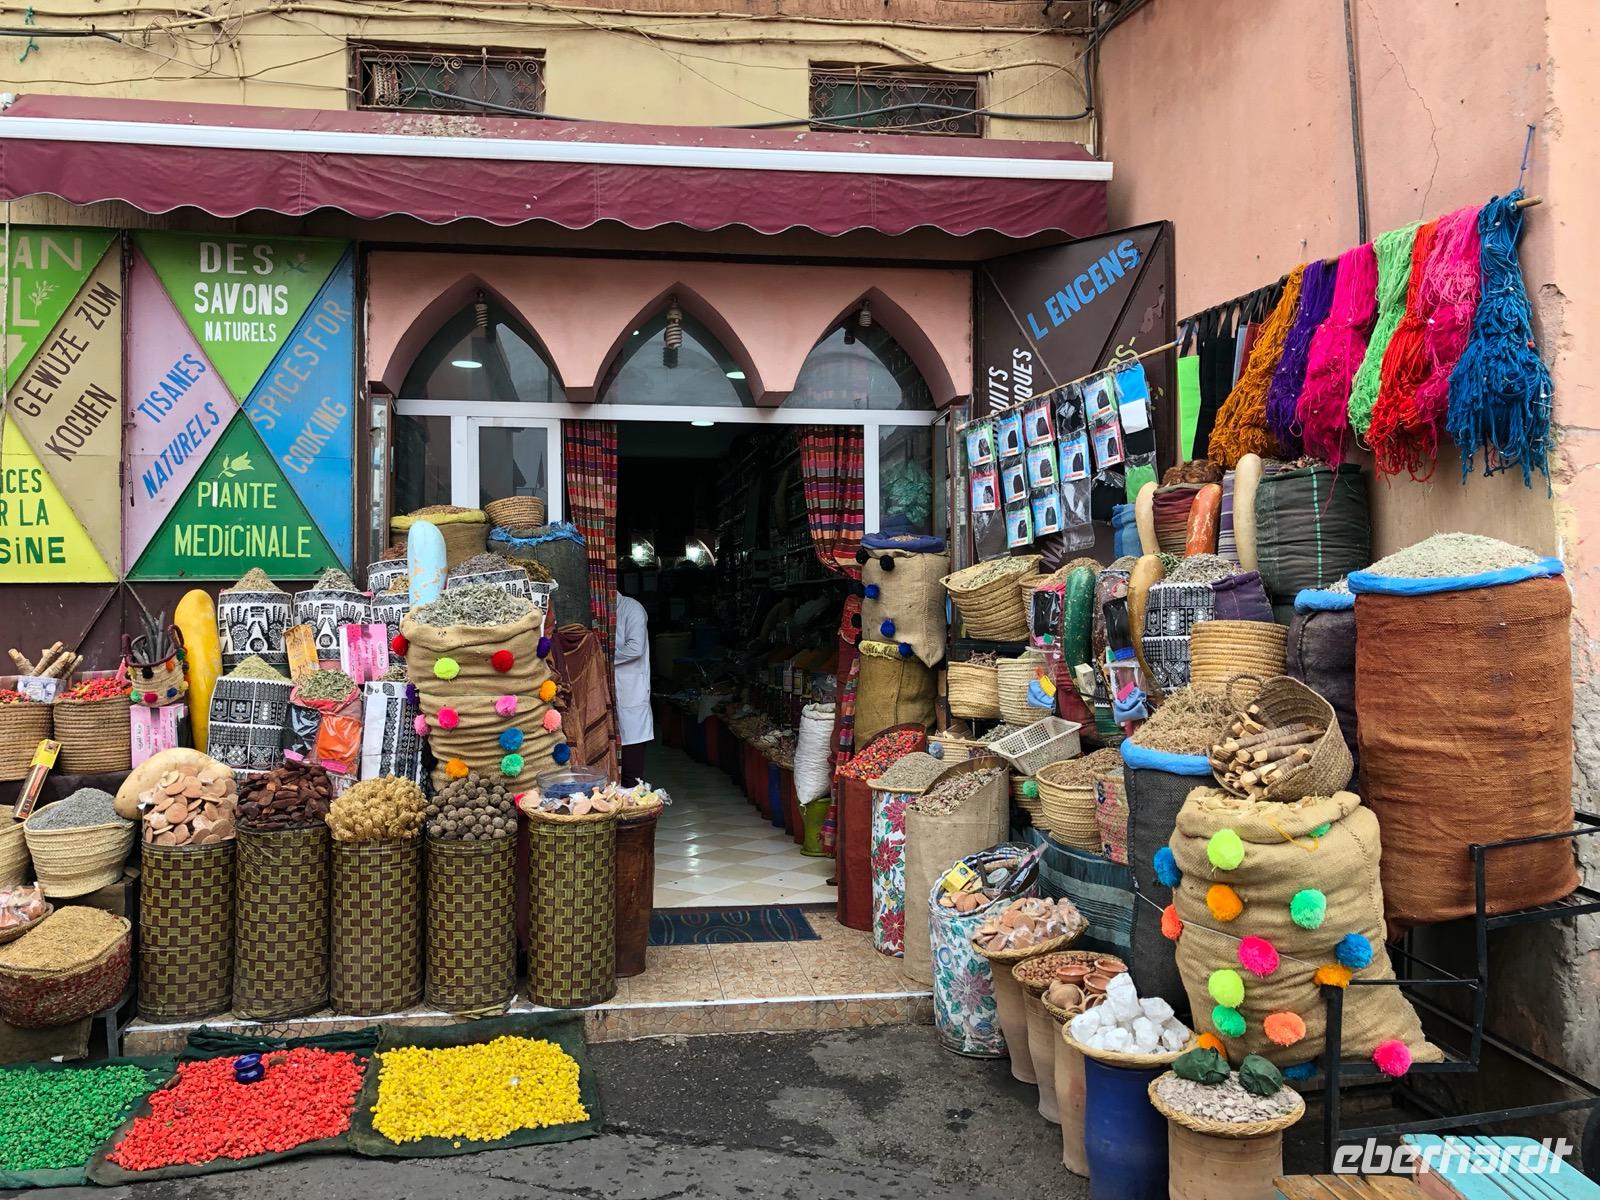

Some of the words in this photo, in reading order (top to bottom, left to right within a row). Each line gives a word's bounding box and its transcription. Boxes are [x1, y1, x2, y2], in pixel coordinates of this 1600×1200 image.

[200, 242, 274, 275] DES
[1043, 239, 1141, 327] ENCENS
[194, 281, 288, 316] SAVONS
[205, 320, 277, 342] NATURELS
[13, 328, 90, 417] GEWÜZE
[74, 281, 121, 331] ZUM
[137, 353, 206, 423] TISANES
[249, 345, 320, 430] SPICES
[303, 299, 352, 350] FOR
[44, 382, 118, 462] KOCHEN
[142, 401, 220, 499] NATURELS
[283, 396, 347, 474] COOKING
[19, 498, 50, 527] LA
